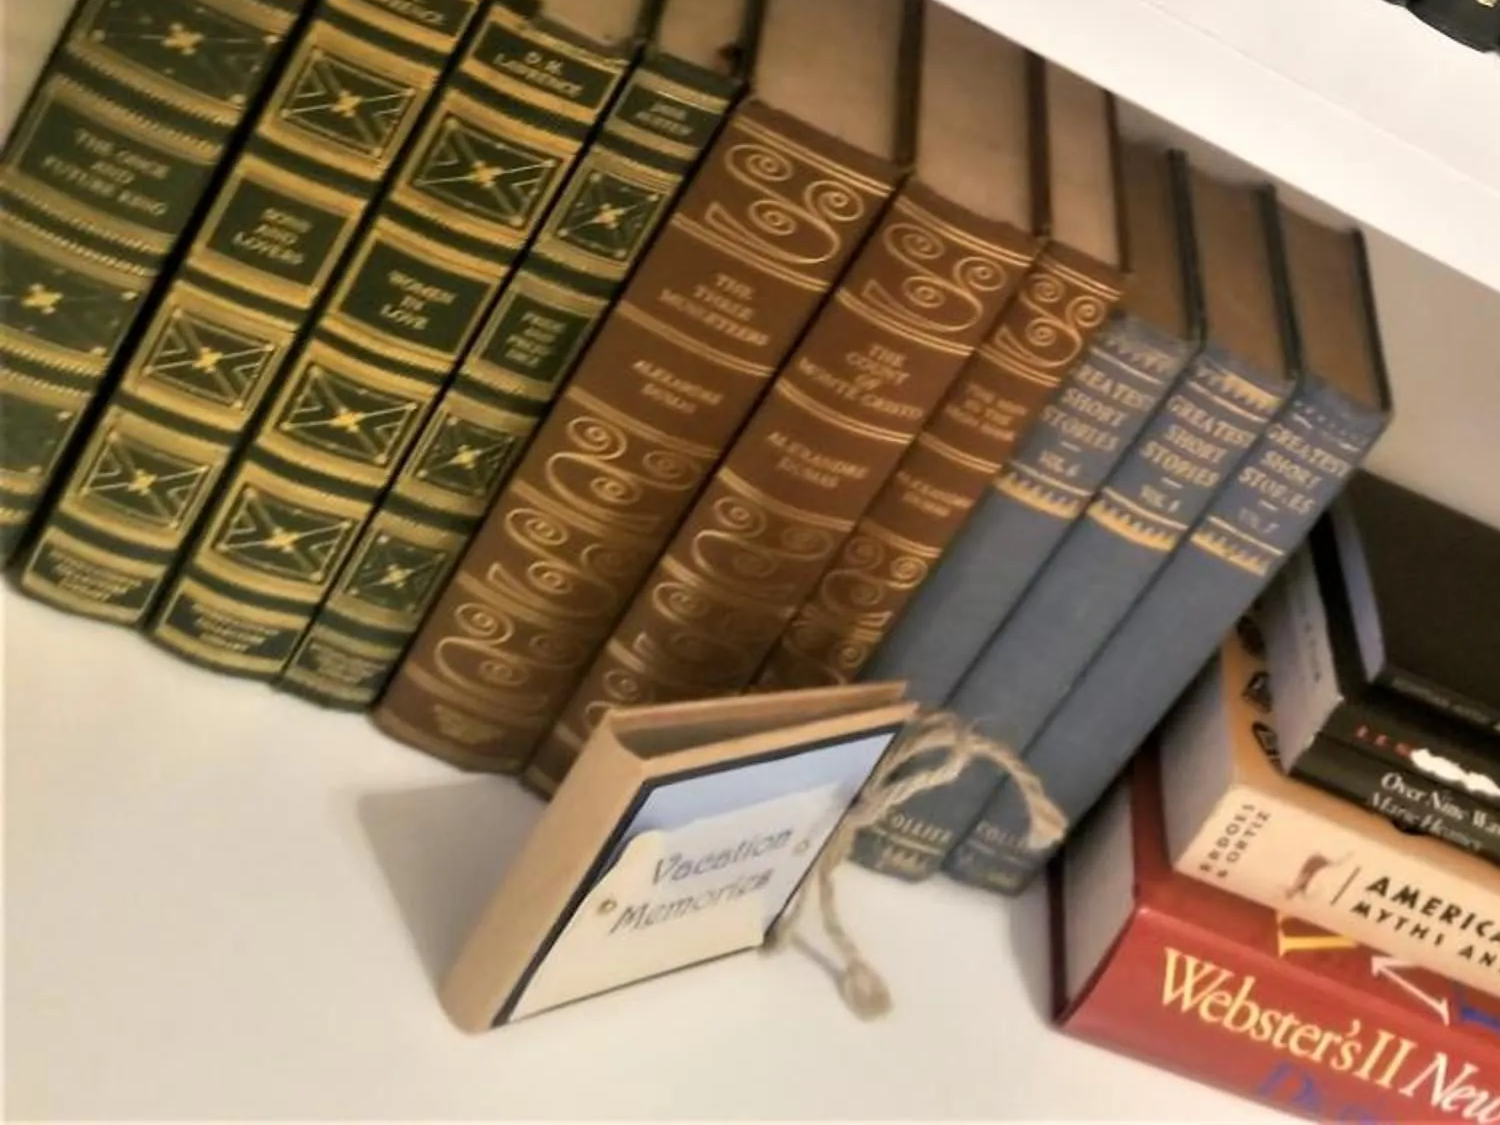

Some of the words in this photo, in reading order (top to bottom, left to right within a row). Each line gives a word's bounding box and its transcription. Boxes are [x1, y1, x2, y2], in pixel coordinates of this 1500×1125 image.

[491, 51, 585, 101] LAWRENCE
[71, 129, 117, 162] THE
[89, 155, 138, 187] AND
[40, 154, 118, 200] FUTURE
[117, 186, 168, 220] KING
[231, 227, 307, 272] LOVERS
[710, 272, 756, 303] THE
[377, 300, 430, 334] LOVE
[842, 348, 911, 389] COUNT
[865, 341, 909, 371] THE
[796, 356, 862, 402] MONTE
[857, 387, 926, 424] CRISTO
[1060, 386, 1129, 431] SHORT
[1038, 404, 1121, 456] STORIES
[1162, 422, 1228, 467] SHORT
[1164, 393, 1254, 450] GREATEST
[1139, 439, 1222, 491] STORIES
[1260, 448, 1325, 493] SHORT
[1266, 421, 1354, 481] GREATEST
[1378, 768, 1429, 805] Over
[1425, 788, 1471, 823] Nine
[648, 828, 794, 884] Vacation
[1198, 799, 1257, 874] ERDOES
[1224, 807, 1272, 865] ORTIZ
[1348, 897, 1448, 951] MYTHS
[1161, 946, 1363, 1072] Webster's
[1352, 1029, 1417, 1090] II
